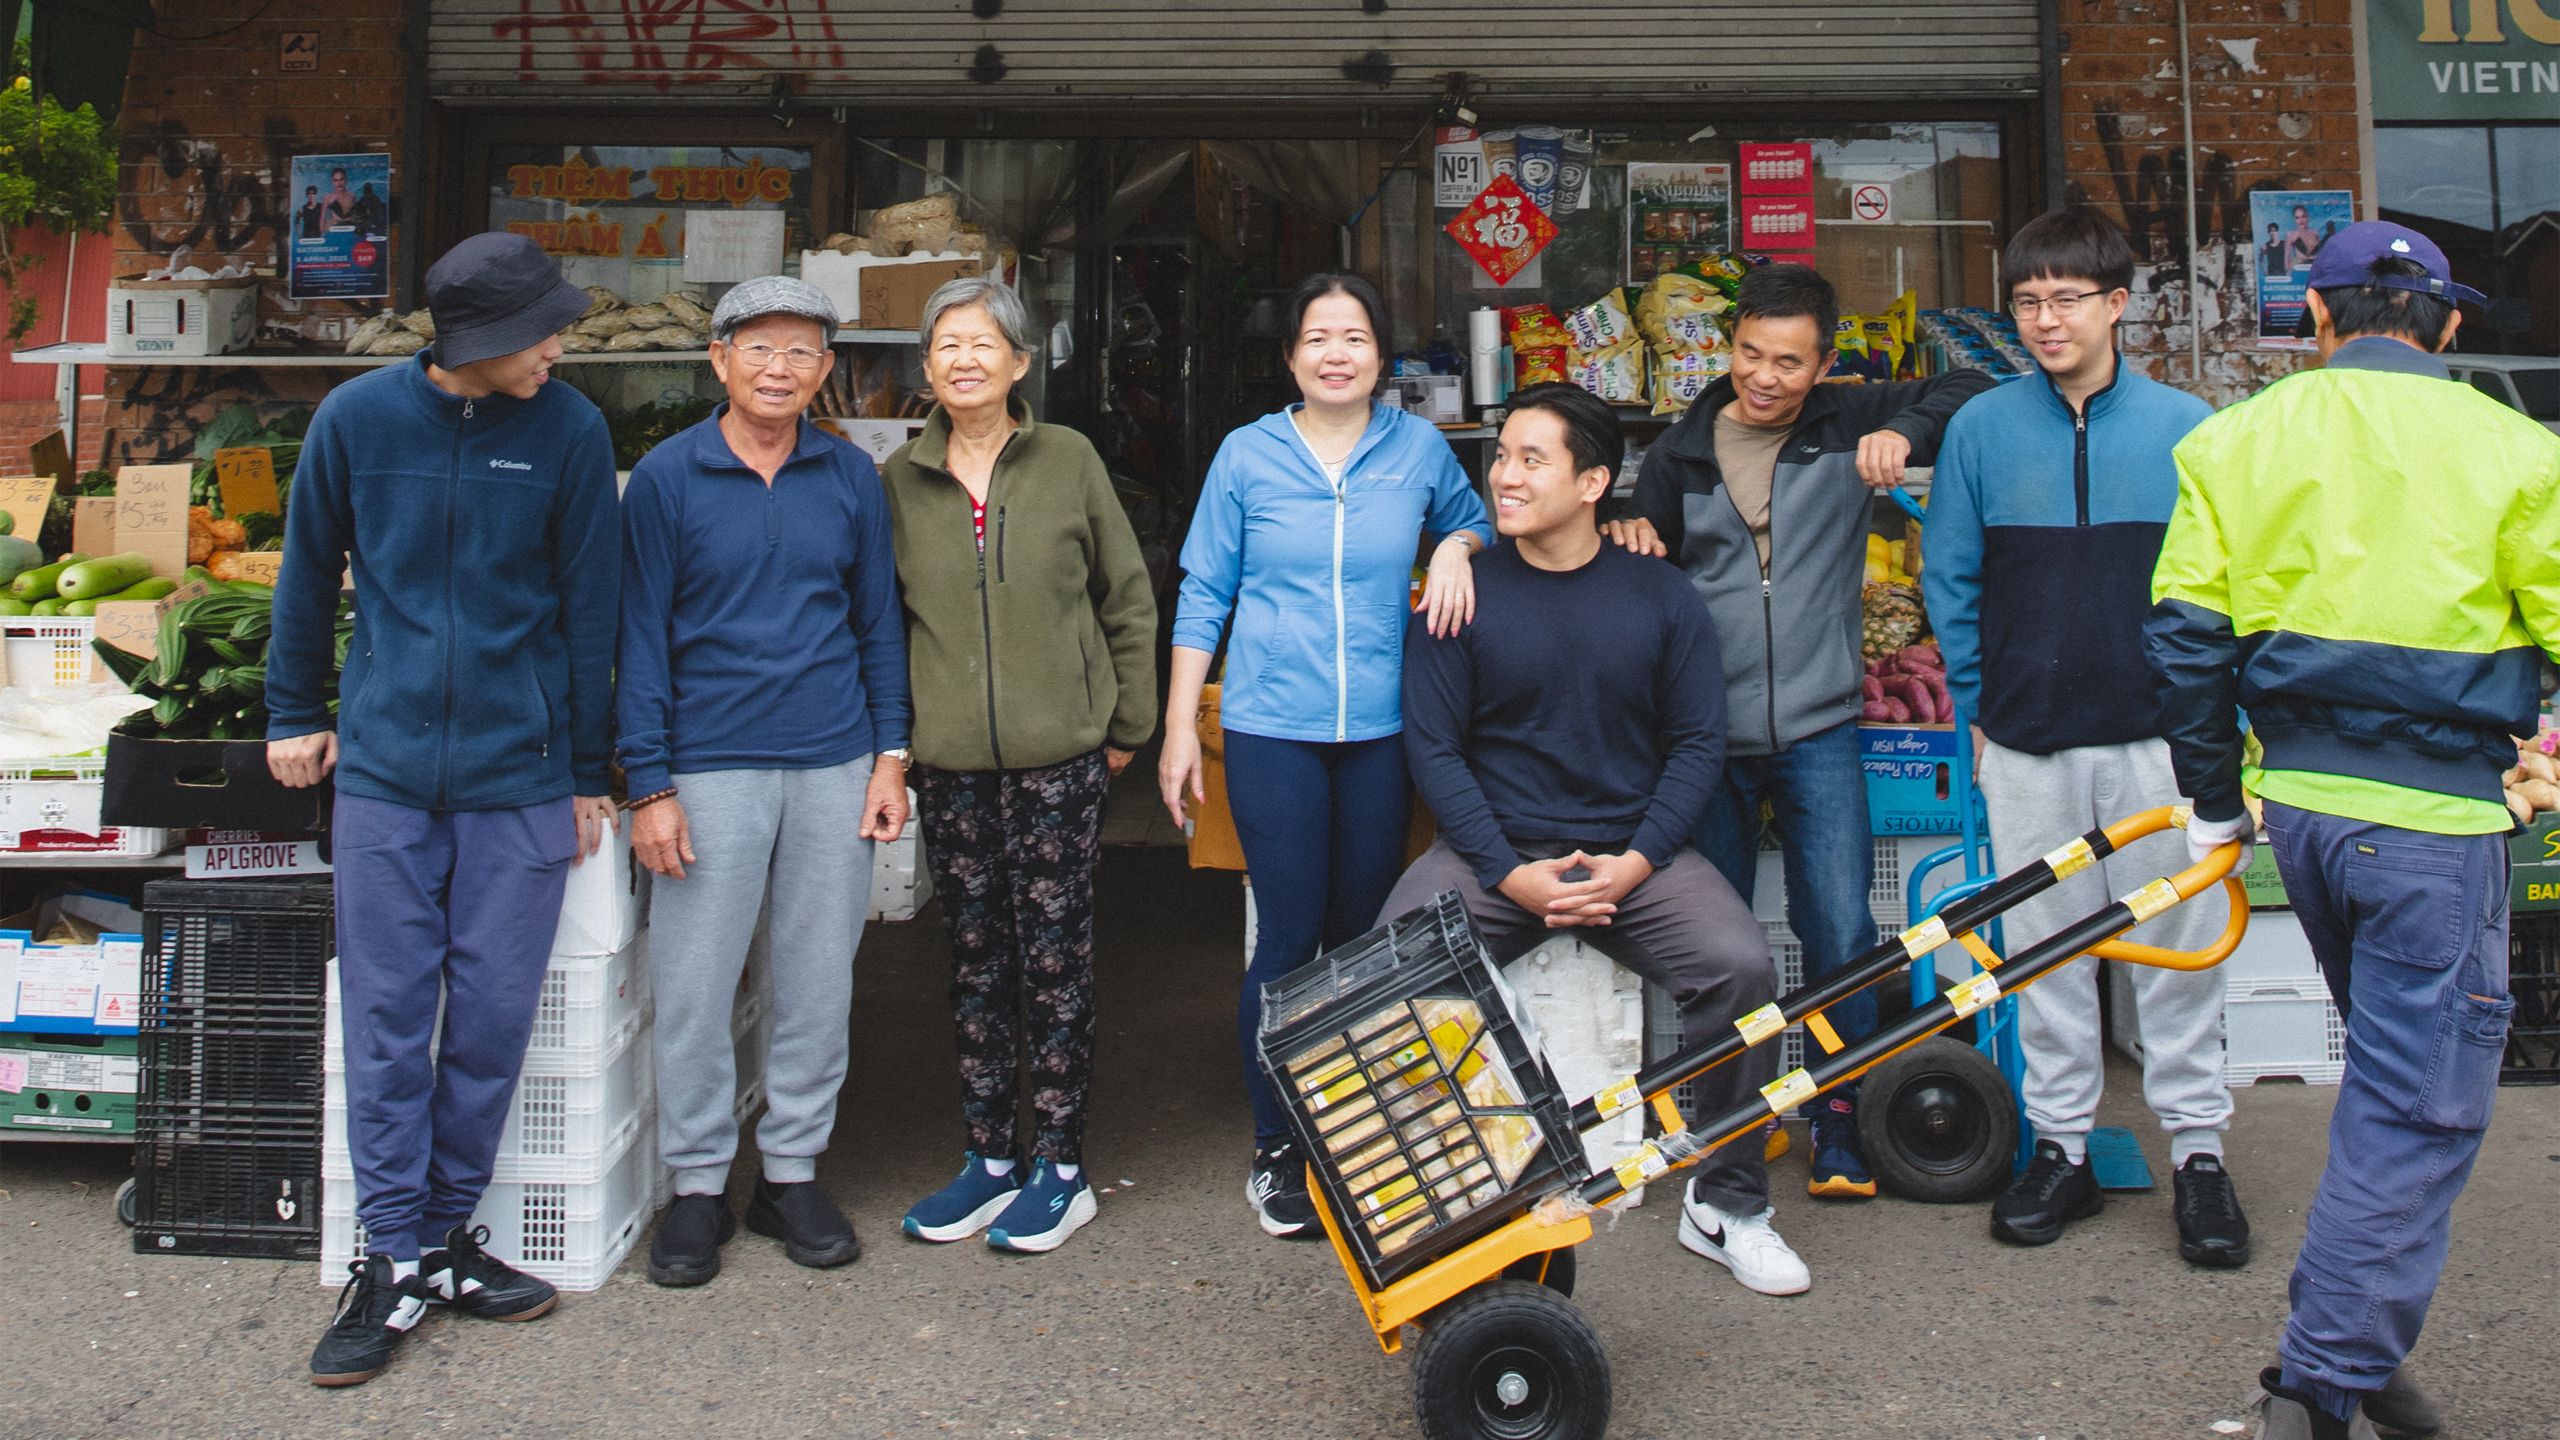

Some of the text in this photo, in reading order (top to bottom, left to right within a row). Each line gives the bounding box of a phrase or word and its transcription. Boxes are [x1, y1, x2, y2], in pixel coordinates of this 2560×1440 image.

[285, 61, 312, 69] CCTV
[2428, 62, 2560, 93] VIETN
[508, 154, 791, 208] TIỆM THỰC
[1441, 185, 1463, 193] COFFEE
[498, 459, 532, 470] Columbia
[1884, 817, 1986, 832] PTATOES
[207, 830, 260, 844] CHERRIES
[205, 845, 298, 870] APLGROVE
